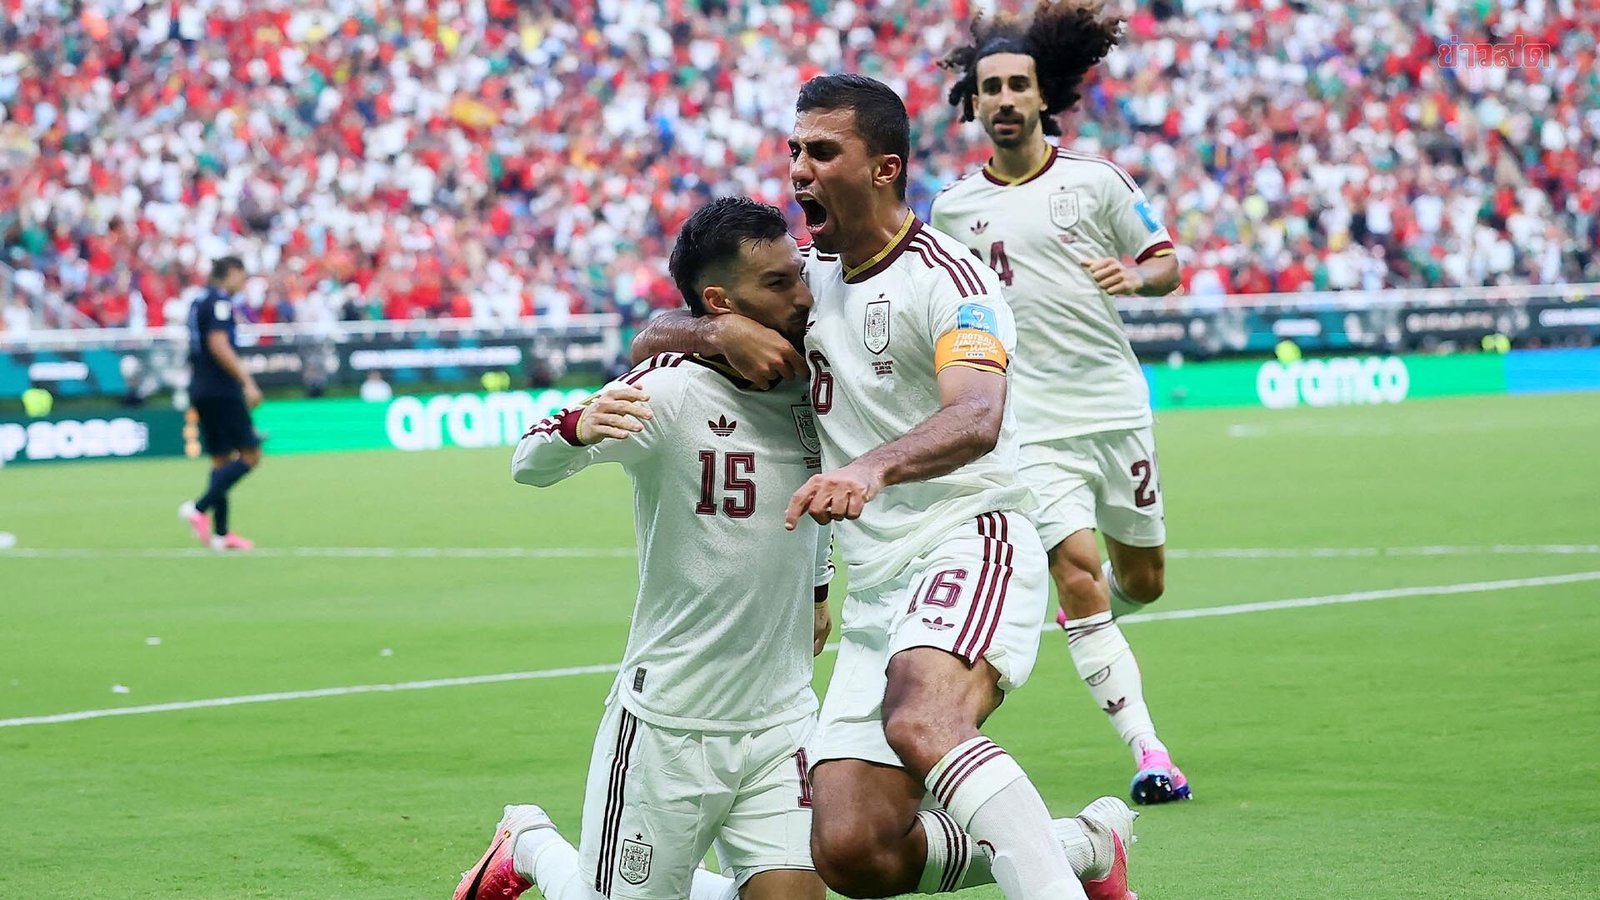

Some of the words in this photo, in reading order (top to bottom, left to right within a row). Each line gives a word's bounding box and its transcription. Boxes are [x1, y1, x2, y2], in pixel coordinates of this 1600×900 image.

[1256, 357, 1410, 409] aramco
[695, 449, 757, 519] 15
[1130, 456, 1161, 508] 2
